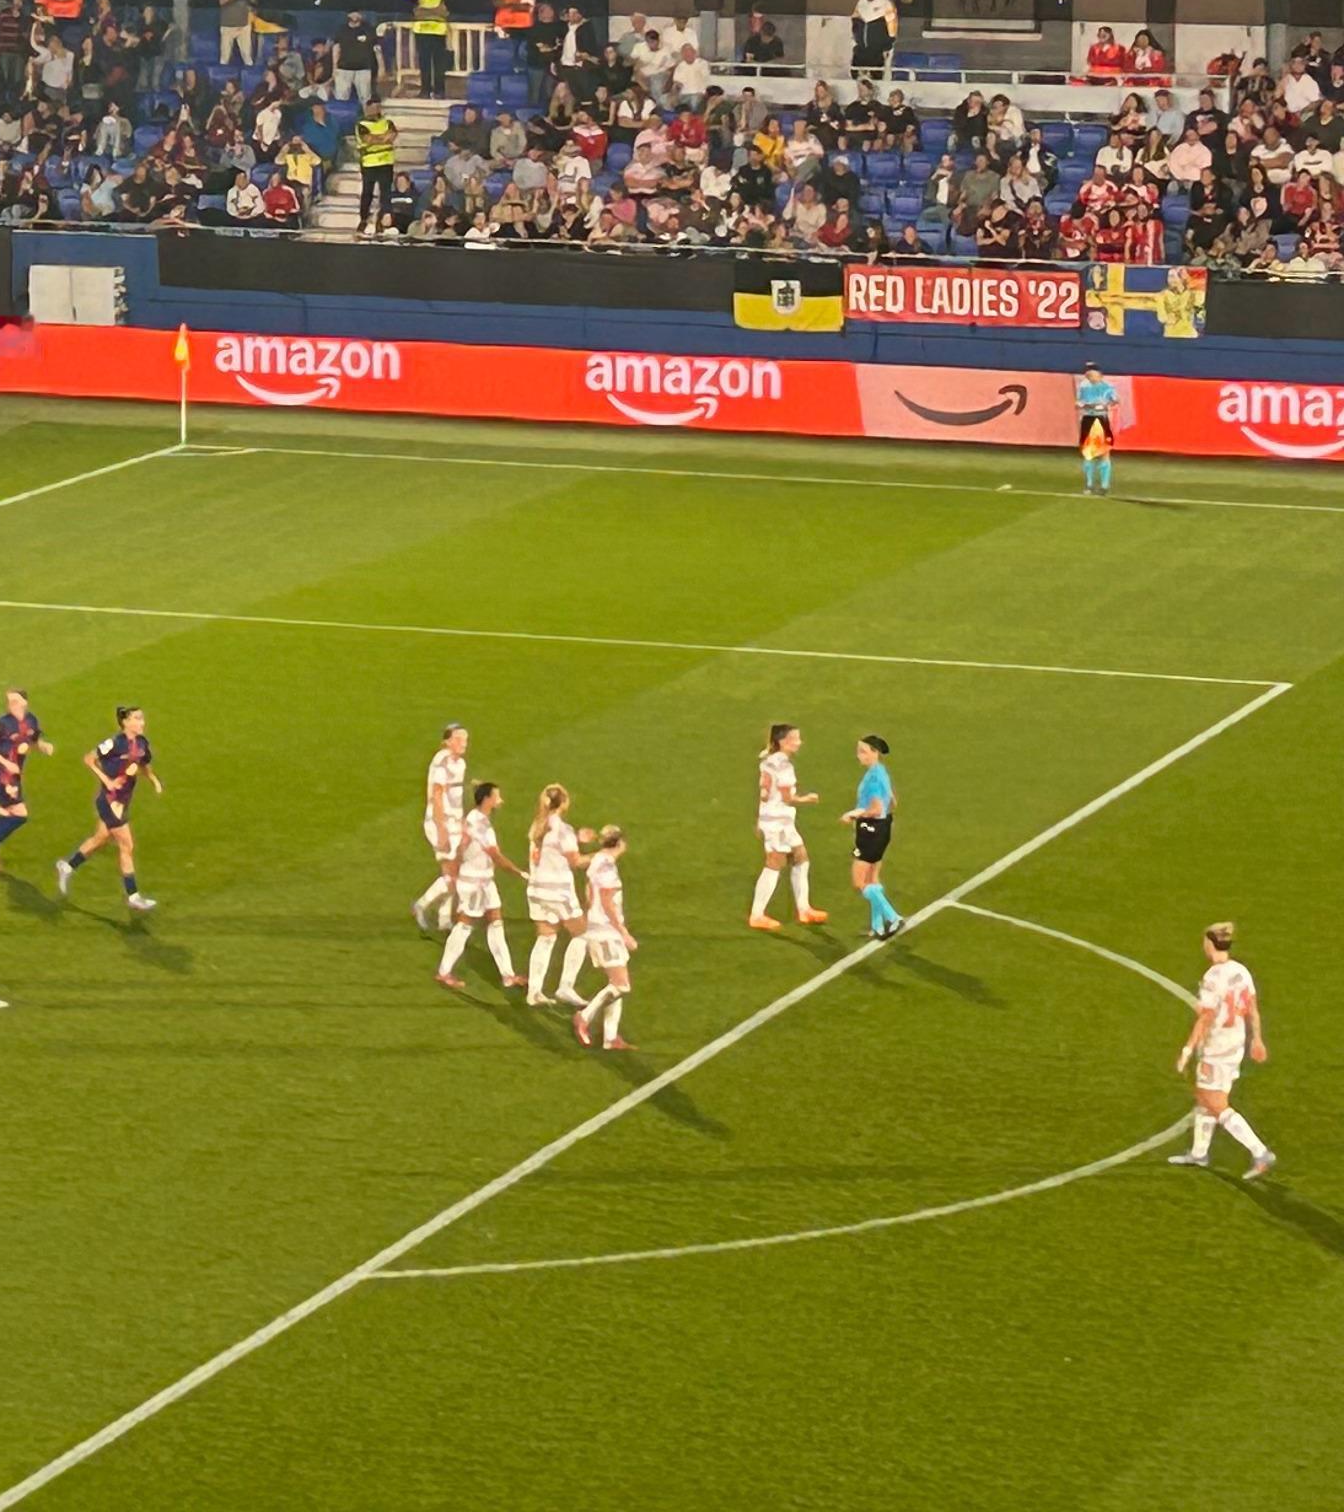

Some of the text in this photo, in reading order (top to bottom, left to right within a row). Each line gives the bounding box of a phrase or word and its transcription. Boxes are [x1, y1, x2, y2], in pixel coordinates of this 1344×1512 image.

[848, 273, 1080, 321] RED LADIES '22
[215, 334, 402, 380] amazon
[586, 352, 781, 399] amazon
